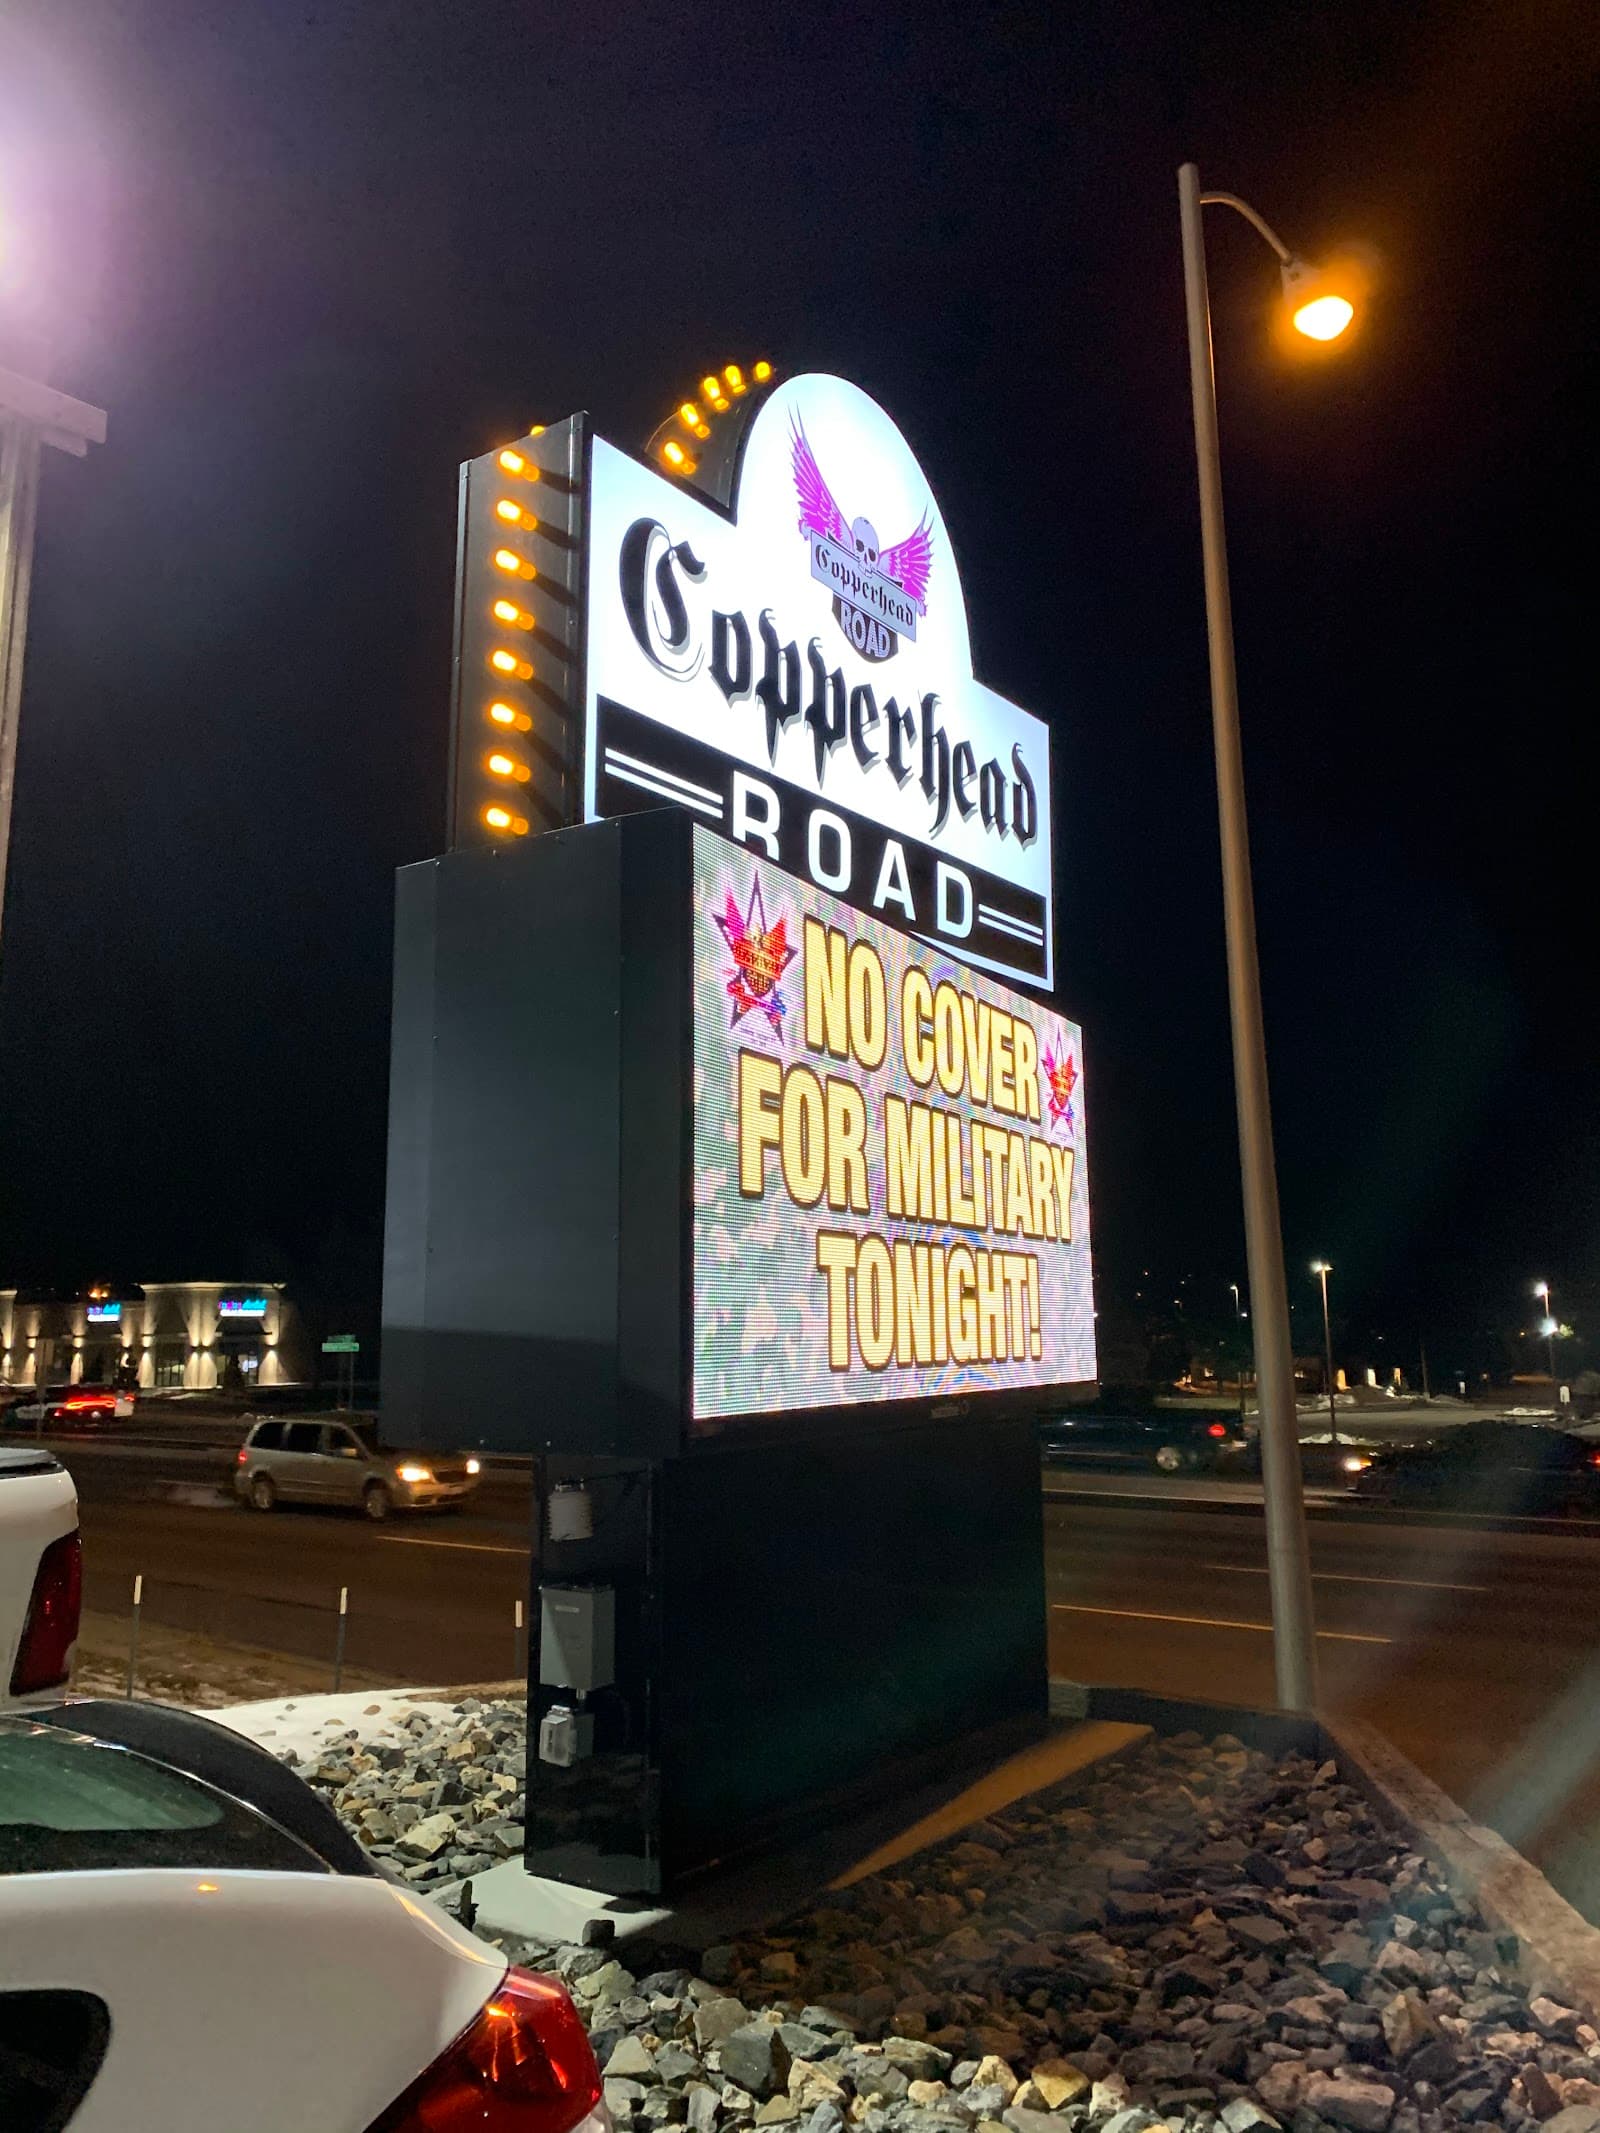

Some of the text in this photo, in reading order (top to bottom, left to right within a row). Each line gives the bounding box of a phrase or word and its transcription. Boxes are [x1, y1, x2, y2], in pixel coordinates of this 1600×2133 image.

[815, 544, 913, 626] Copperhead
[840, 600, 891, 658] ROAD
[619, 517, 1040, 852] Copperhead
[732, 770, 974, 939] ROAD
[804, 915, 1041, 1124] NO COVER
[738, 1047, 1075, 1243] FOR MILITARY
[816, 1229, 1043, 1372] TONIGHT!
